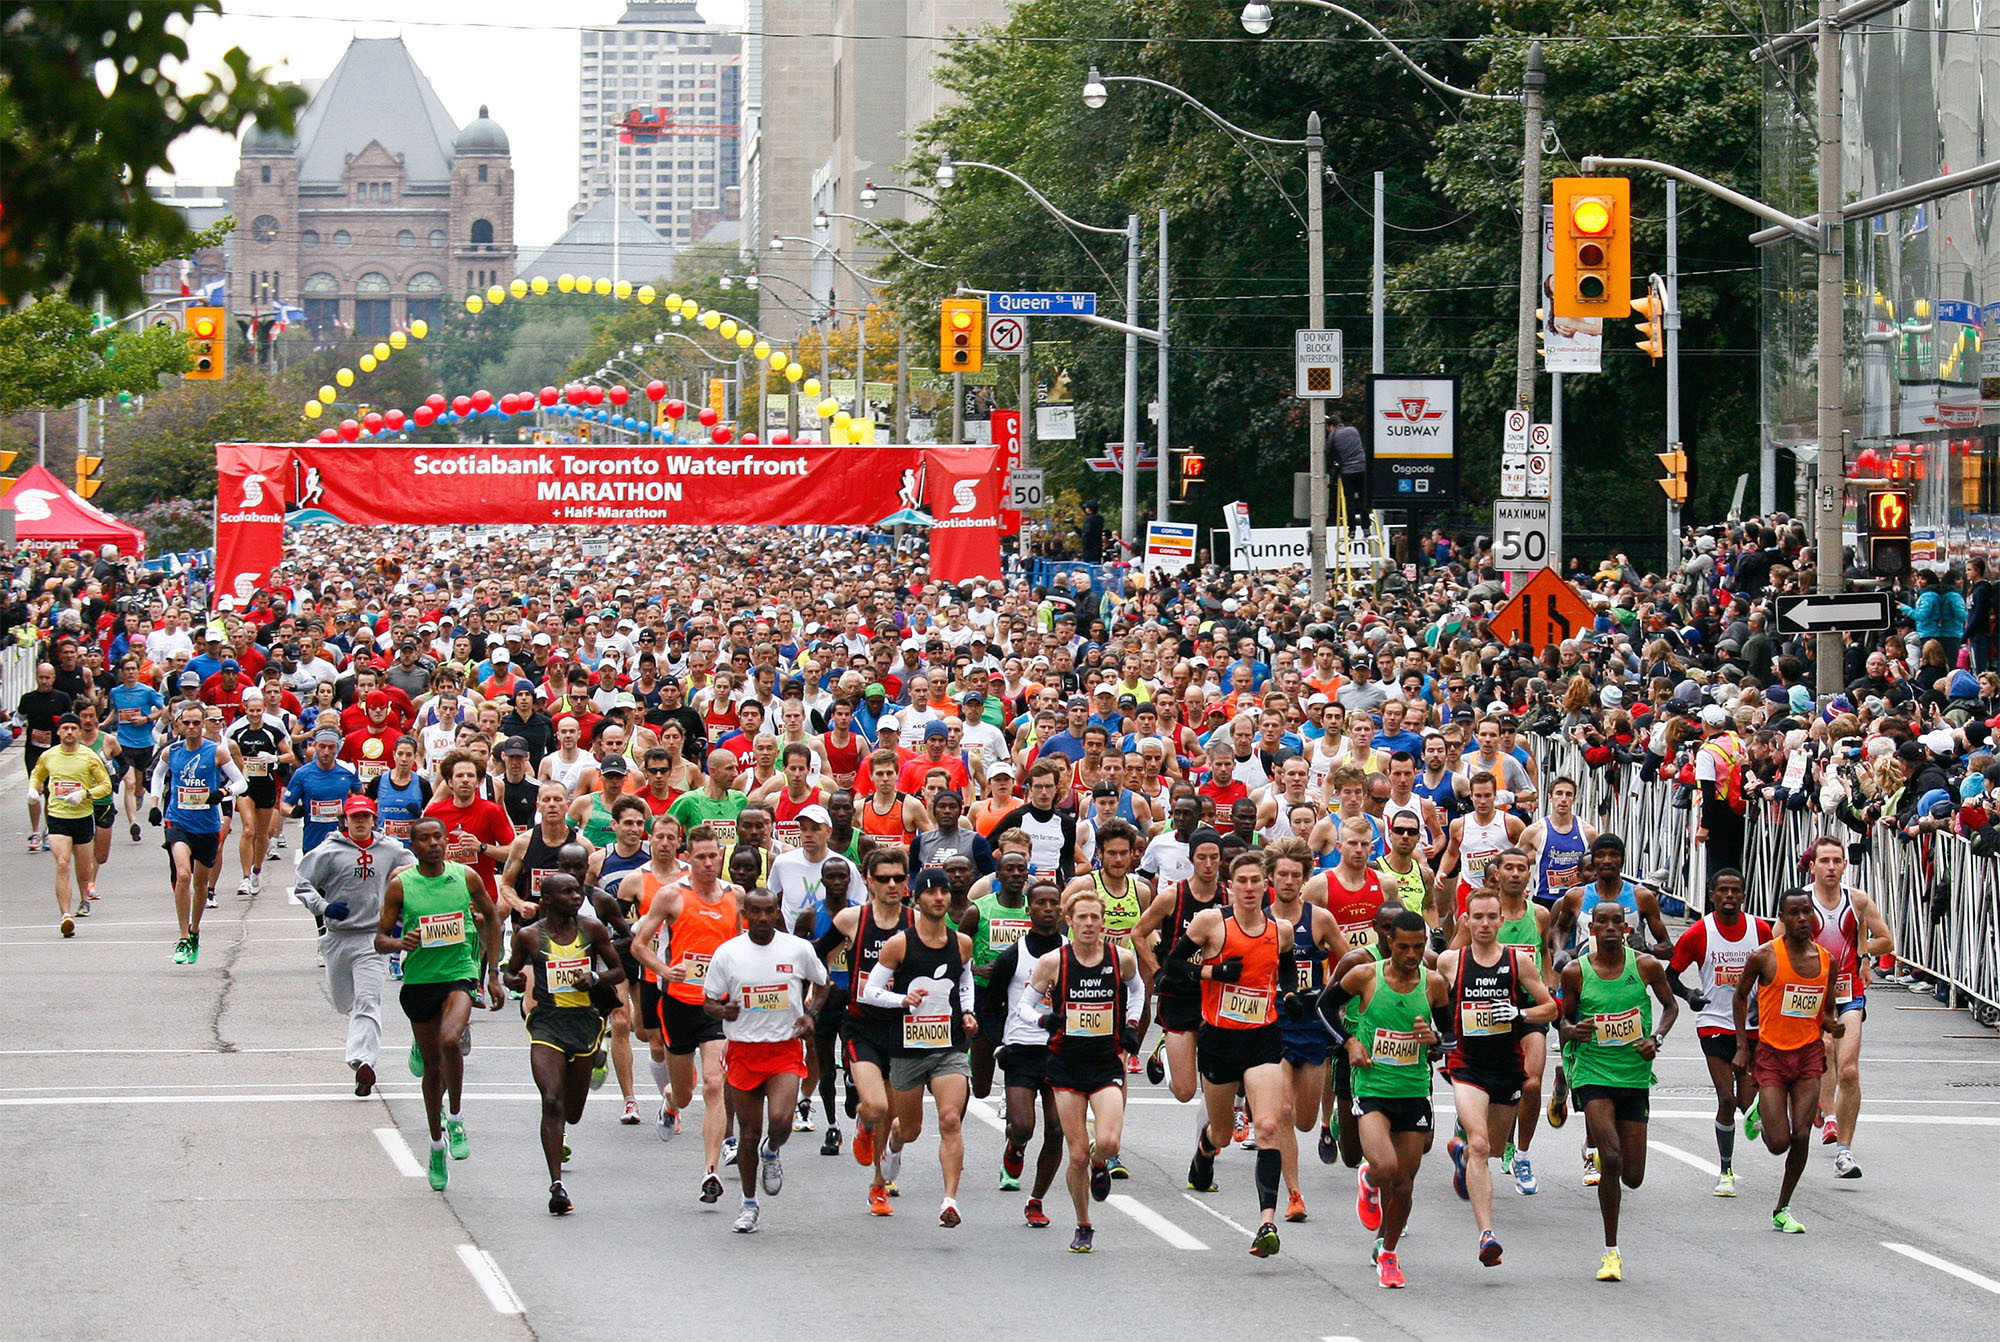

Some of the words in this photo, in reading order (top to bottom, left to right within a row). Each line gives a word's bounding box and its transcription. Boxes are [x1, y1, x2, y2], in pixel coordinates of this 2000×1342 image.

[999, 295, 1050, 311] Queen
[1055, 295, 1064, 303] St
[1072, 295, 1085, 310] W
[1304, 333, 1315, 341] DO
[1318, 333, 1334, 341] NOT
[1306, 344, 1332, 352] BLOCK
[1300, 355, 1338, 363] INTERSECTION
[1387, 426, 1440, 436] SUBWAY
[1508, 434, 1524, 442] SNOW
[1506, 442, 1525, 450] ROUTE
[414, 454, 553, 475] Scotiabank
[560, 455, 658, 475] Toronto
[666, 455, 808, 476] Waterfront
[1392, 464, 1435, 475] Osgoode
[537, 481, 683, 502] MARATHON
[1507, 484, 1520, 492] ZONE
[1014, 486, 1041, 504] 50
[564, 506, 667, 518] Half-Marathon
[1499, 509, 1546, 520] MAXIMUM
[932, 516, 997, 528] Scotiabank
[1502, 530, 1546, 562] 50
[184, 778, 206, 786] VFAC
[426, 921, 460, 939] MWANGI
[1349, 932, 1368, 946] 40
[1080, 979, 1102, 987] new
[1475, 977, 1497, 986] new
[1070, 988, 1114, 998] balance
[1465, 987, 1509, 997] balance
[758, 993, 779, 1004] MARK
[1791, 995, 1817, 1010] PACER
[1231, 996, 1259, 1014] DYLAN
[1080, 1013, 1101, 1028] ERIC
[906, 1024, 949, 1040] BRANDON
[1605, 1020, 1634, 1037] PACER
[1375, 1040, 1418, 1057] ABRAHAM
